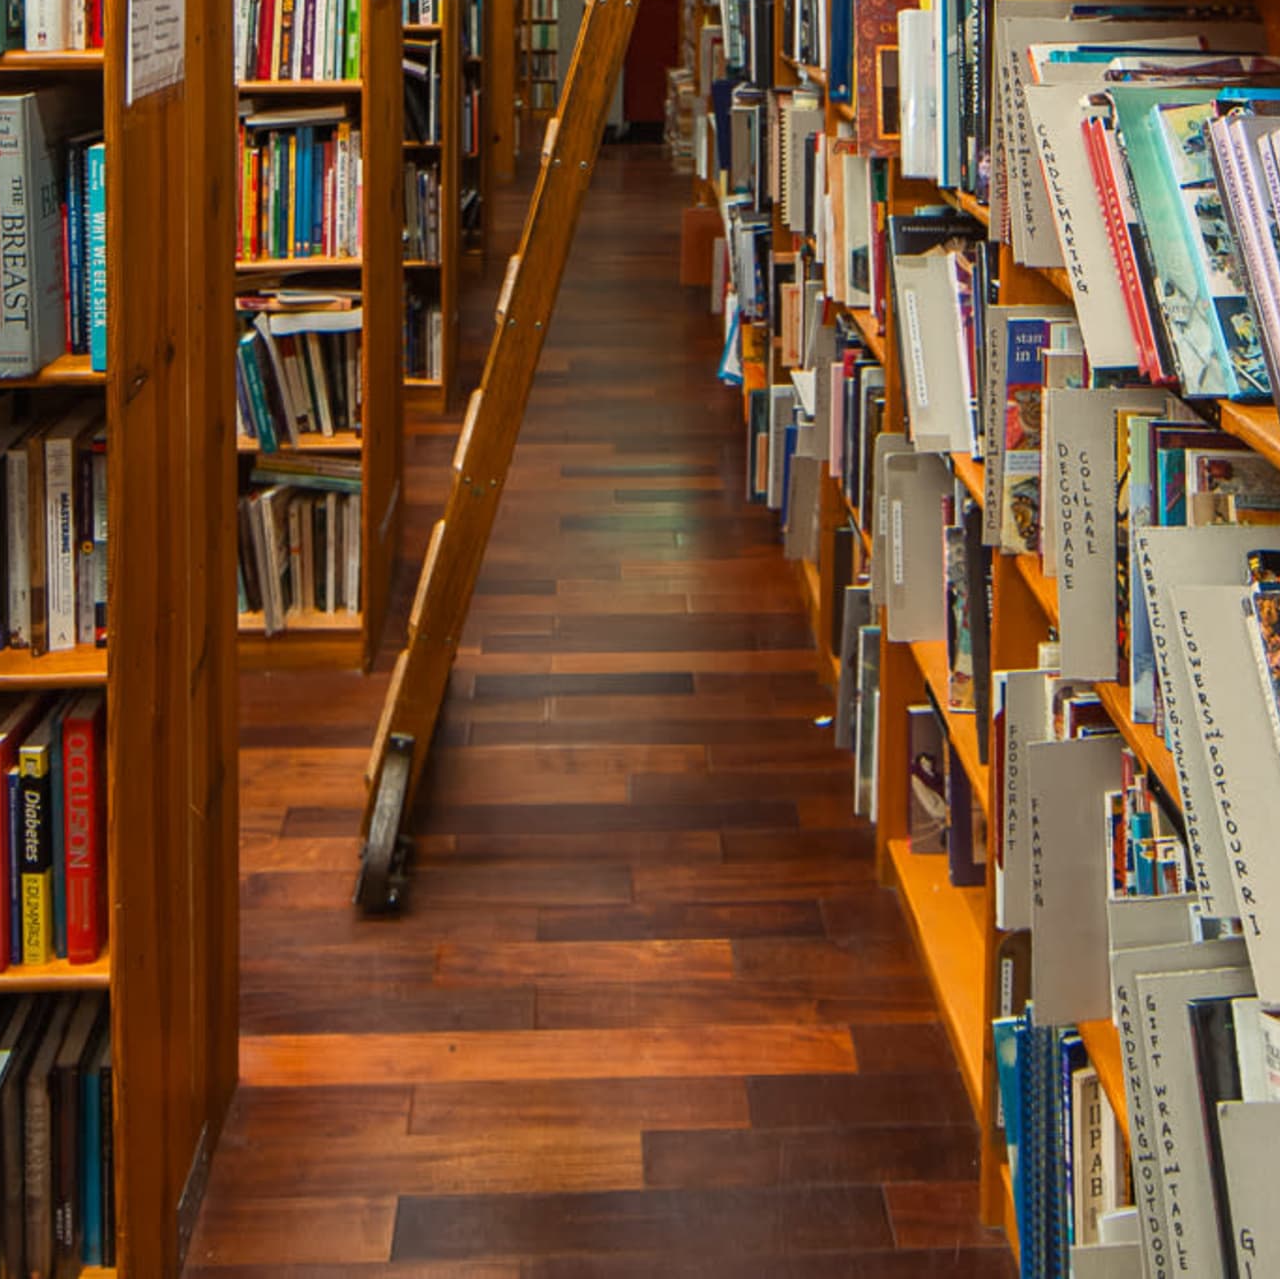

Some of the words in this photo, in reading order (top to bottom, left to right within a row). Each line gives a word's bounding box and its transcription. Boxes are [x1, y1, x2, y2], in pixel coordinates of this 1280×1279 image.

[10, 176, 25, 206] THE
[92, 211, 106, 241] WHY
[1036, 122, 1089, 295] CANDLEMAKING
[1, 214, 30, 331] BREAST
[92, 245, 106, 266] WE
[93, 269, 107, 293] GET
[93, 297, 108, 328] SICK
[1057, 441, 1075, 592] DECOUPAGE
[67, 733, 89, 869] OCCLUSION
[1008, 723, 1019, 853] FOODCRAFT
[1178, 609, 1215, 730] FLOWERS
[1210, 744, 1262, 938] POTPOURRI
[23, 789, 42, 863] Diabetes
[1144, 993, 1163, 1070] GIFT
[1153, 1084, 1175, 1155] WRAP
[1167, 1181, 1190, 1272] TABLE
